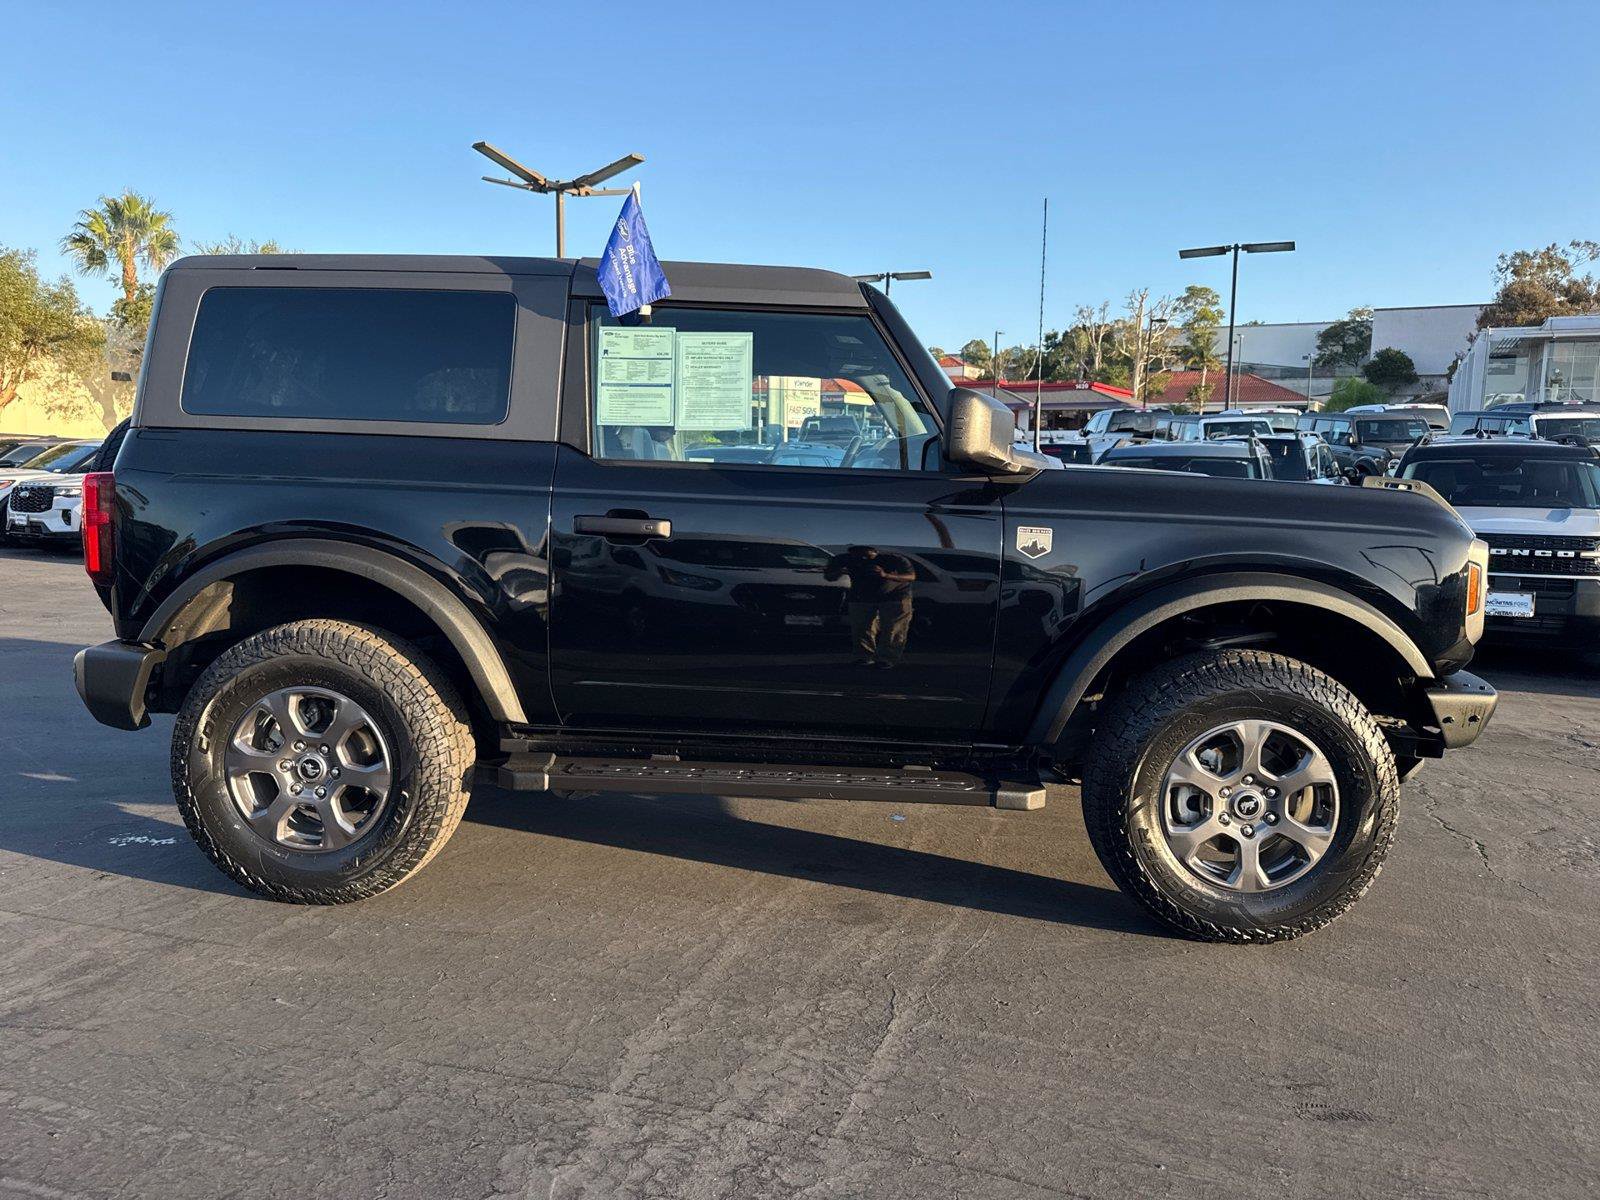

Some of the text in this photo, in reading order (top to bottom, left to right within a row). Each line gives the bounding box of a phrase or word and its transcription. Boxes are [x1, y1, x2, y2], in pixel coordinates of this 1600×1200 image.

[626, 244, 636, 265] Blue
[619, 247, 637, 294] Advantage
[1489, 548, 1575, 558] ONCO
